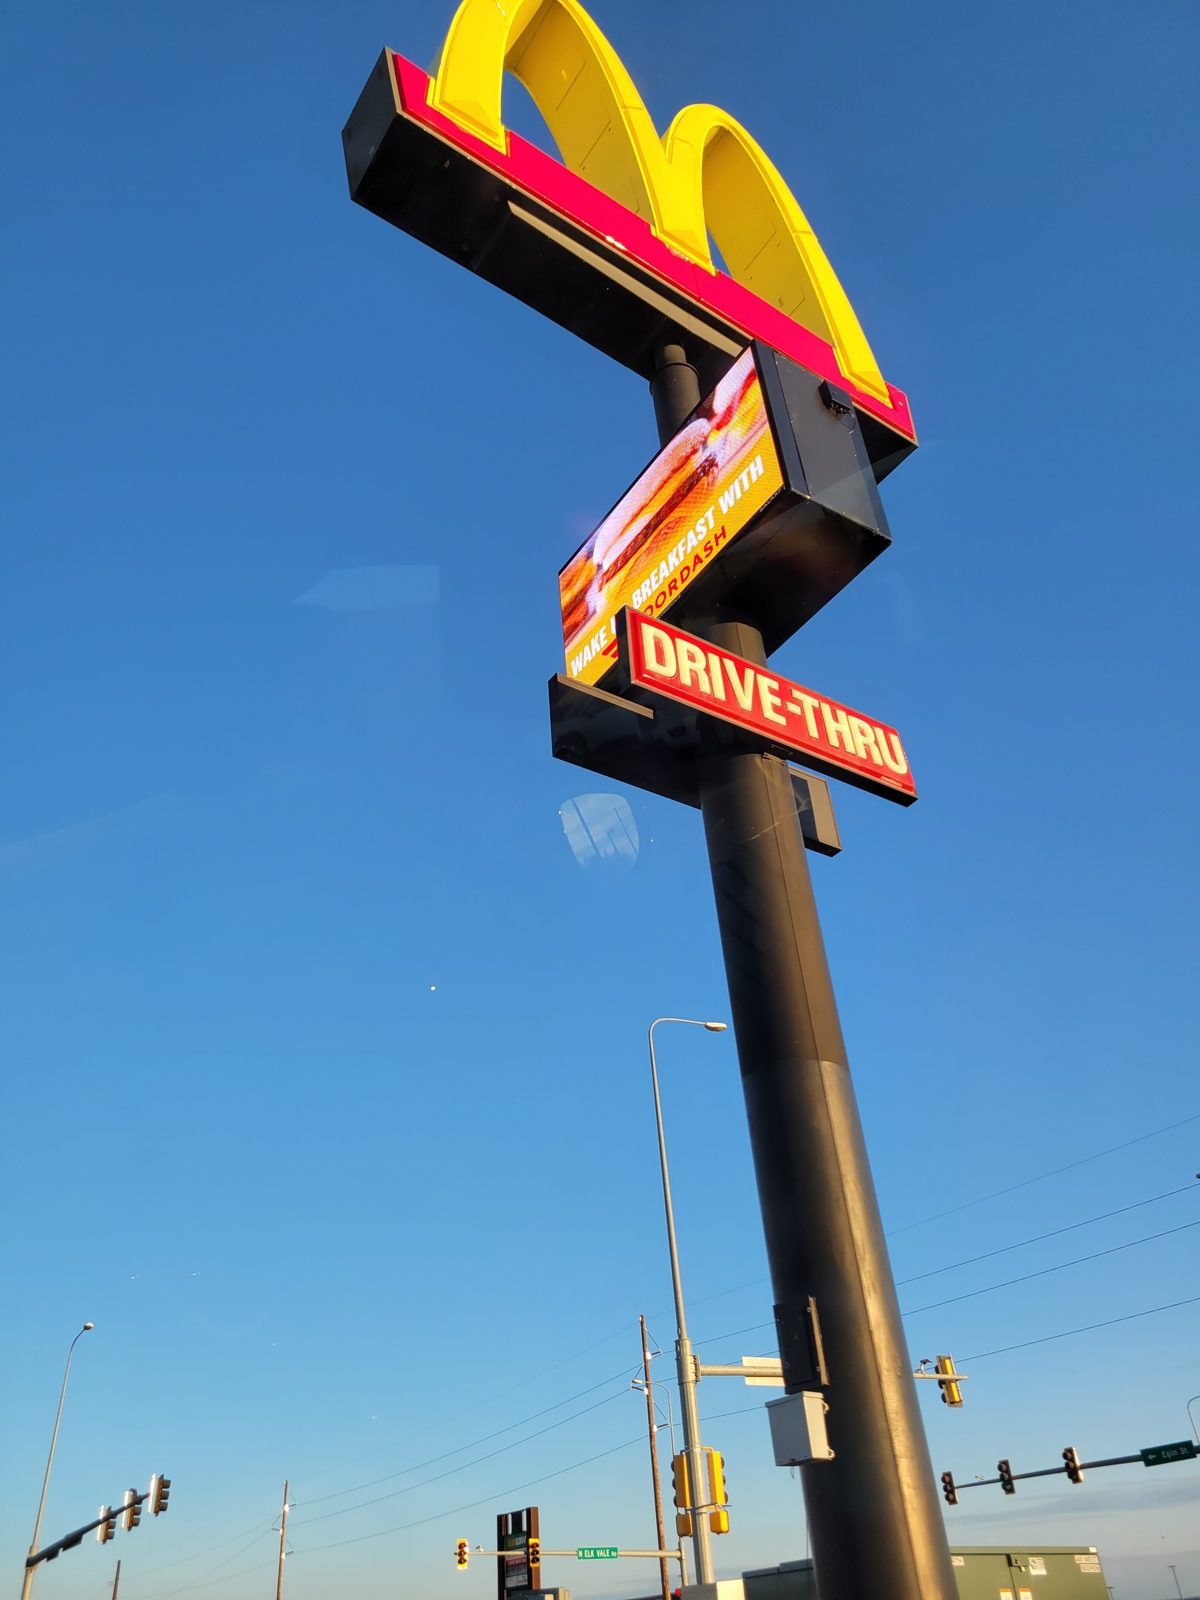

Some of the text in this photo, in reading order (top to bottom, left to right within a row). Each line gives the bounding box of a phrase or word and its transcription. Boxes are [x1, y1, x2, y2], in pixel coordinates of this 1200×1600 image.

[569, 626, 608, 678] WAKE
[631, 504, 716, 609] BREAKFAST
[717, 453, 765, 516] WITH
[643, 525, 727, 617] OORDASH
[641, 622, 909, 776] DRIVE-THRU
[578, 1549, 583, 1558] N
[584, 1549, 595, 1558] ELK
[596, 1548, 610, 1557] VALE
